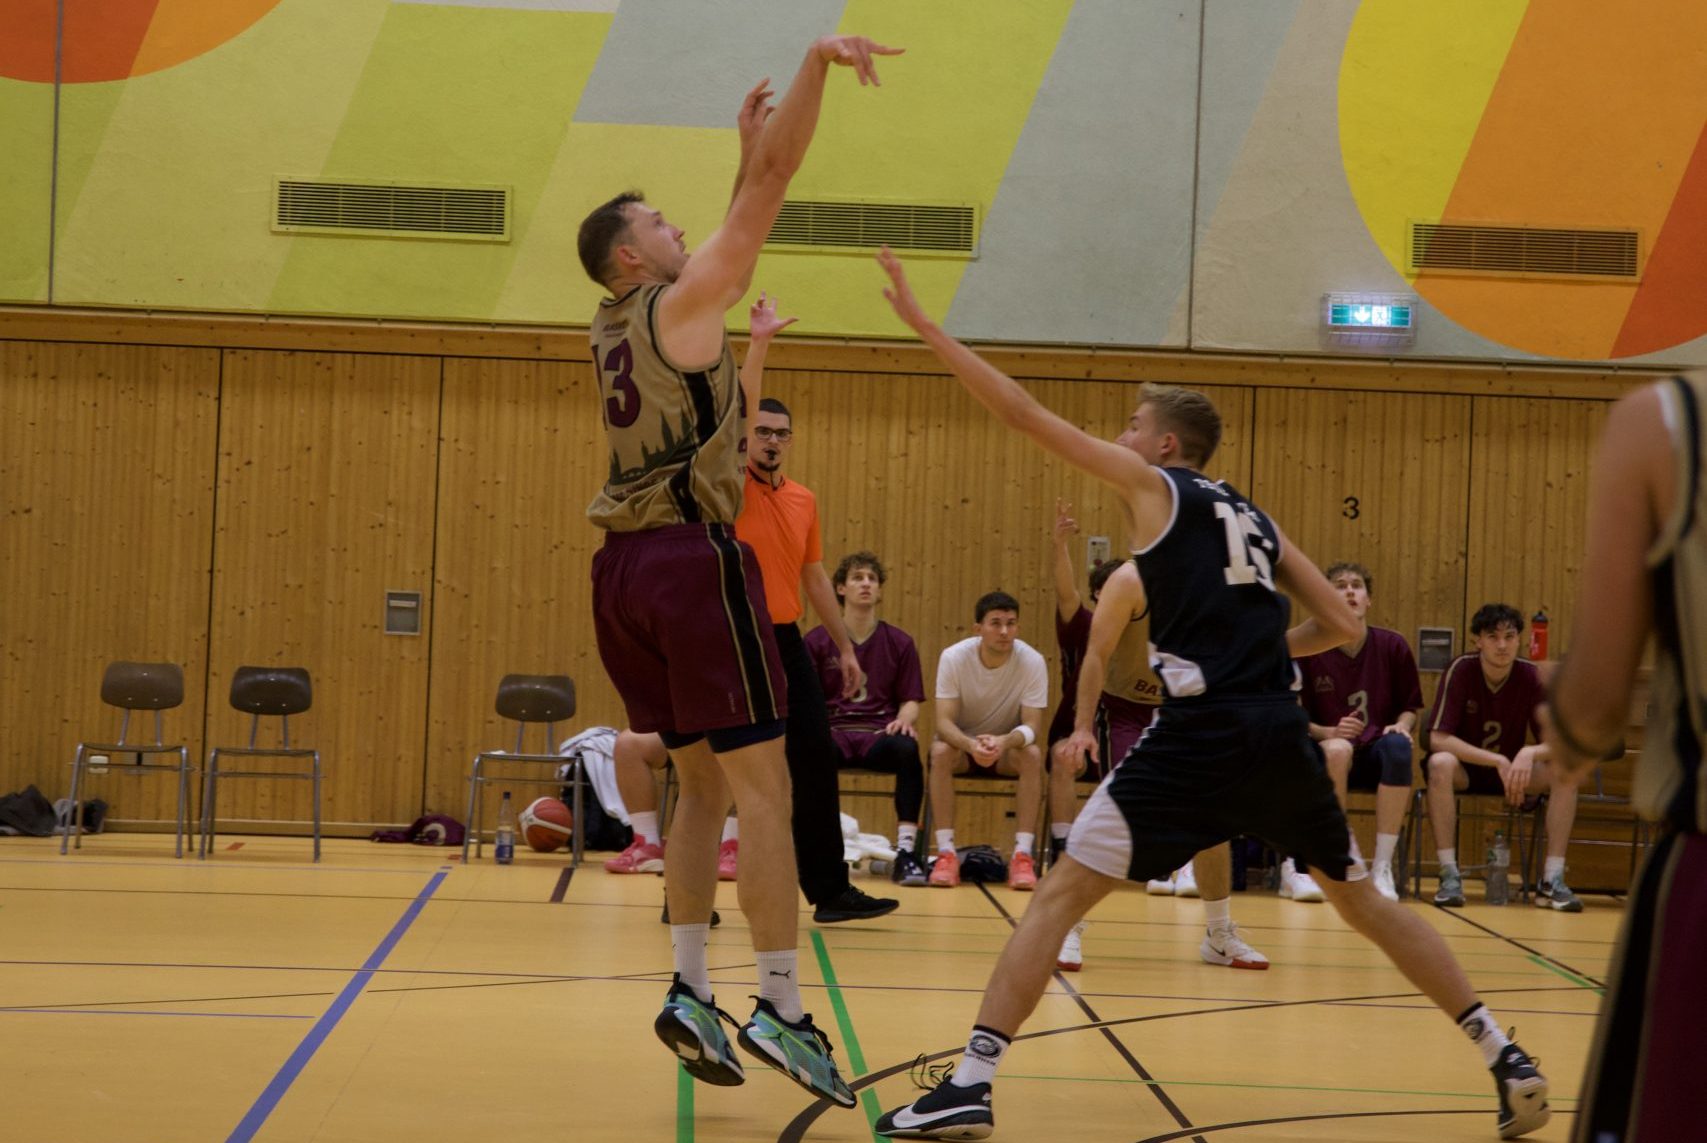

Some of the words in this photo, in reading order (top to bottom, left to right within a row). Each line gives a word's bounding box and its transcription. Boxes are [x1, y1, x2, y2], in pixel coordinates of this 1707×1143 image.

[1342, 496, 1360, 520] 3
[1212, 501, 1277, 592] 15
[1481, 721, 1503, 751] 2
